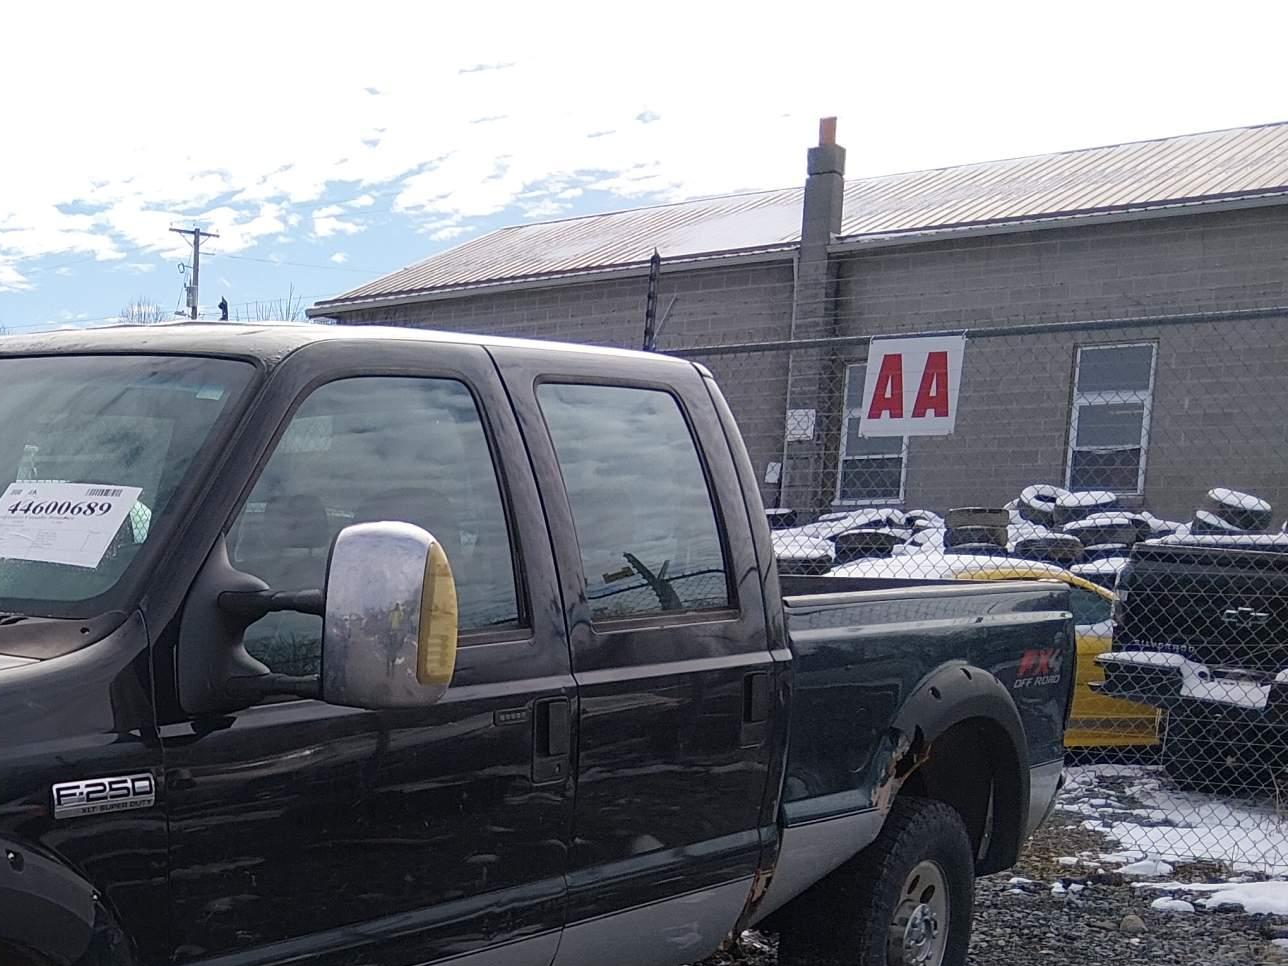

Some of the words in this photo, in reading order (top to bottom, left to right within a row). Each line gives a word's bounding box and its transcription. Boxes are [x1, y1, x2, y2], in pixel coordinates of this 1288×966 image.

[867, 351, 949, 419] AA
[8, 500, 112, 517] 44600689
[1016, 648, 1063, 677] FX4
[1014, 678, 1034, 689] OFF
[1034, 674, 1061, 686] ROAD
[55, 776, 153, 806] F-250
[100, 802, 128, 811] SUPER
[130, 799, 152, 808] DUTY
